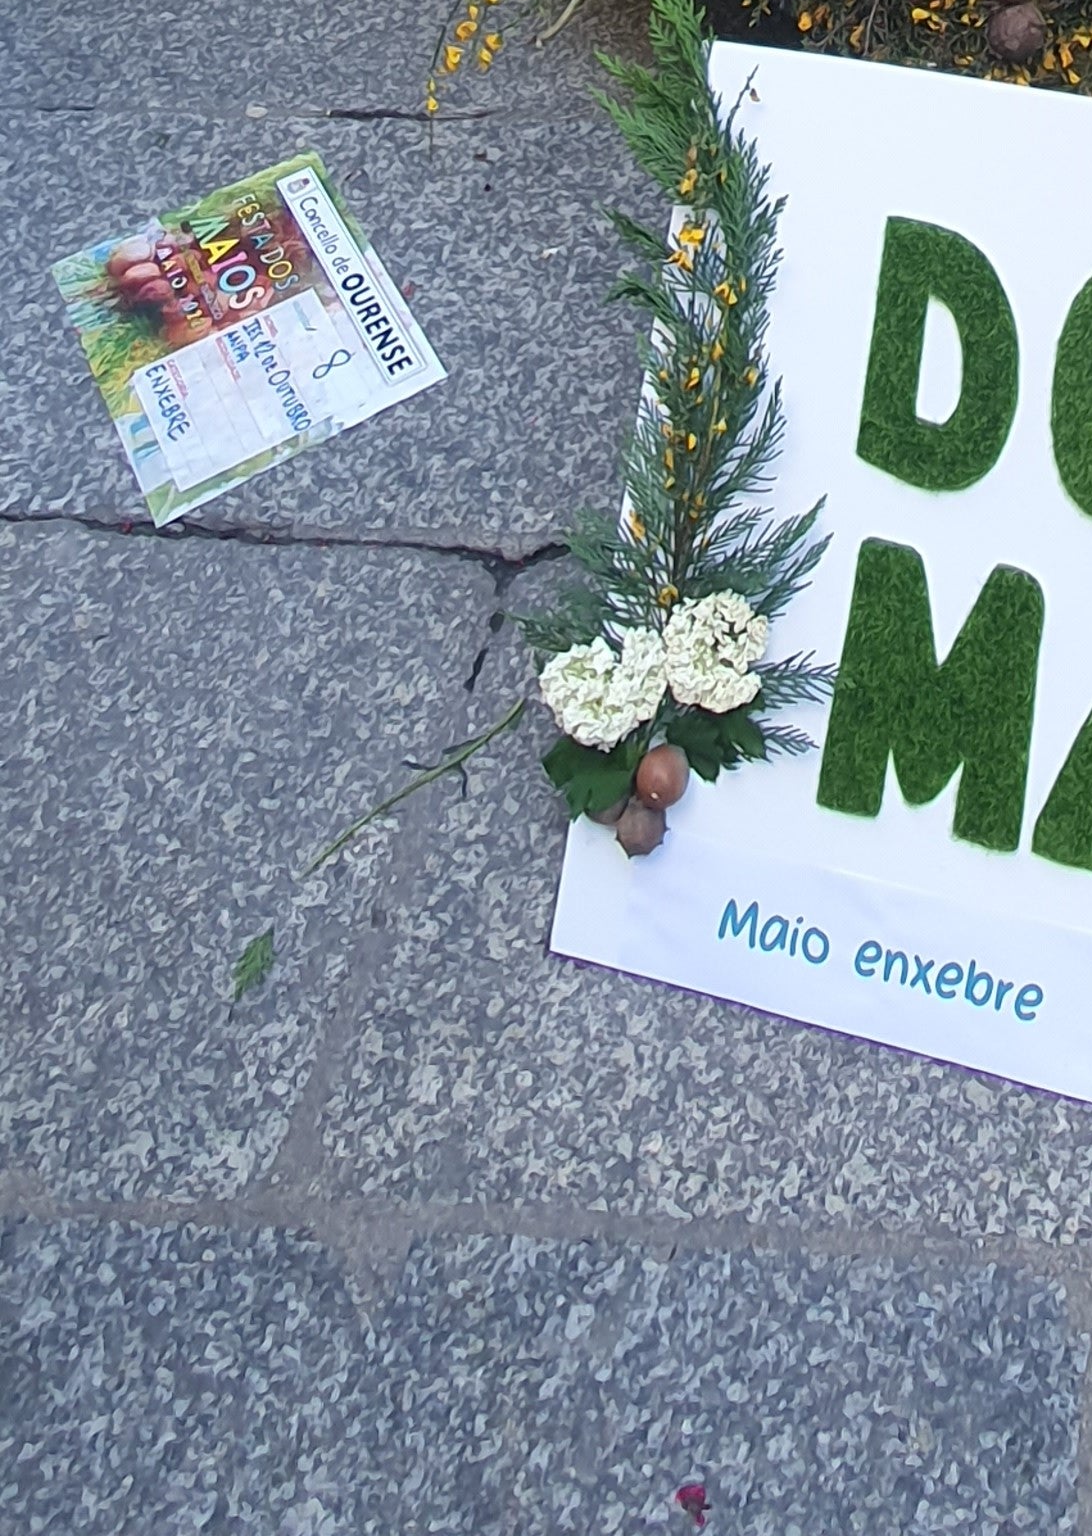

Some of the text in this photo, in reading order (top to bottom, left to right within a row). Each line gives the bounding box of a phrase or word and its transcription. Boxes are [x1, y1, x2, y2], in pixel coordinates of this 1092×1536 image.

[185, 213, 266, 311] MAIOS
[259, 247, 300, 292] DOS
[299, 196, 412, 374] Concello de OURENSE
[224, 330, 249, 362] ANPA
[242, 318, 263, 341] IES
[253, 340, 275, 358] 12
[268, 370, 311, 431] OUTUBRO
[312, 349, 353, 378] 8
[145, 364, 189, 440] ENXEBRE
[718, 898, 1043, 1021] Maio enxebre
